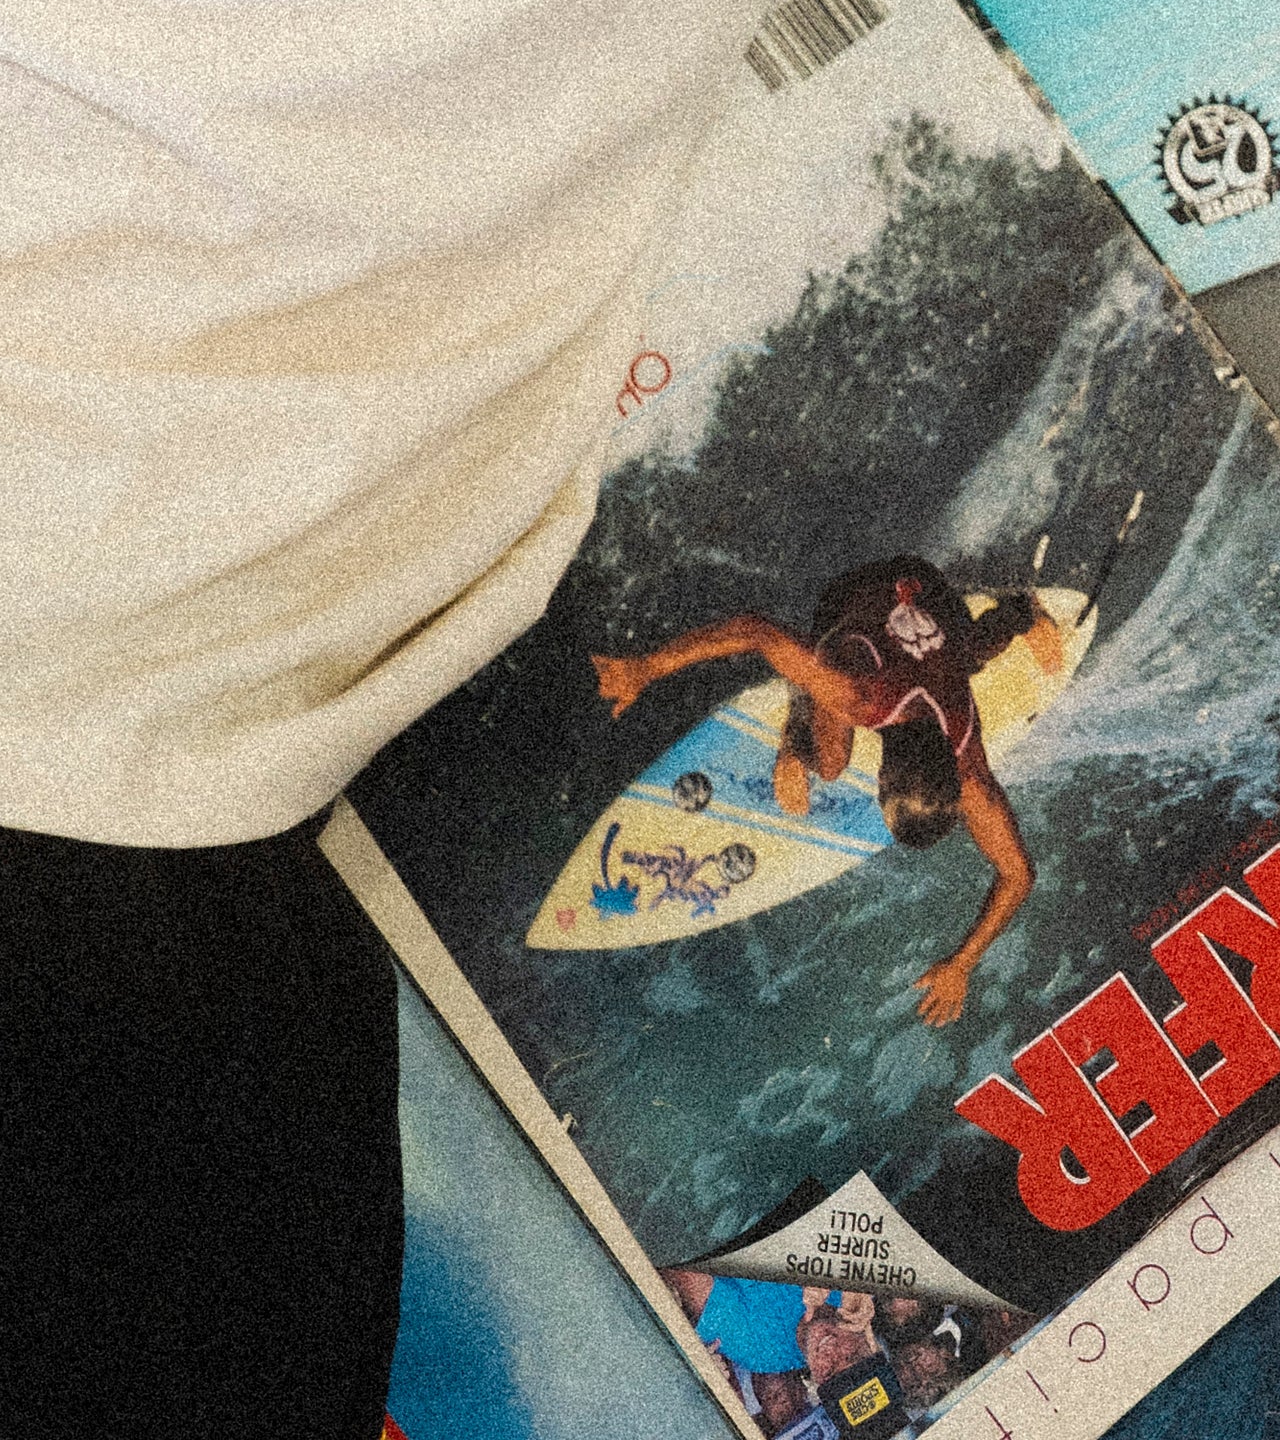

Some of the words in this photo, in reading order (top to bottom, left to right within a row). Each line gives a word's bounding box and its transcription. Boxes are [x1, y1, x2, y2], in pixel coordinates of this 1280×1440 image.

[828, 1208, 884, 1235] POLL!
[816, 1232, 891, 1260] SURFER
[784, 1252, 833, 1278] TOPS
[839, 1258, 917, 1288] CHEYNE
